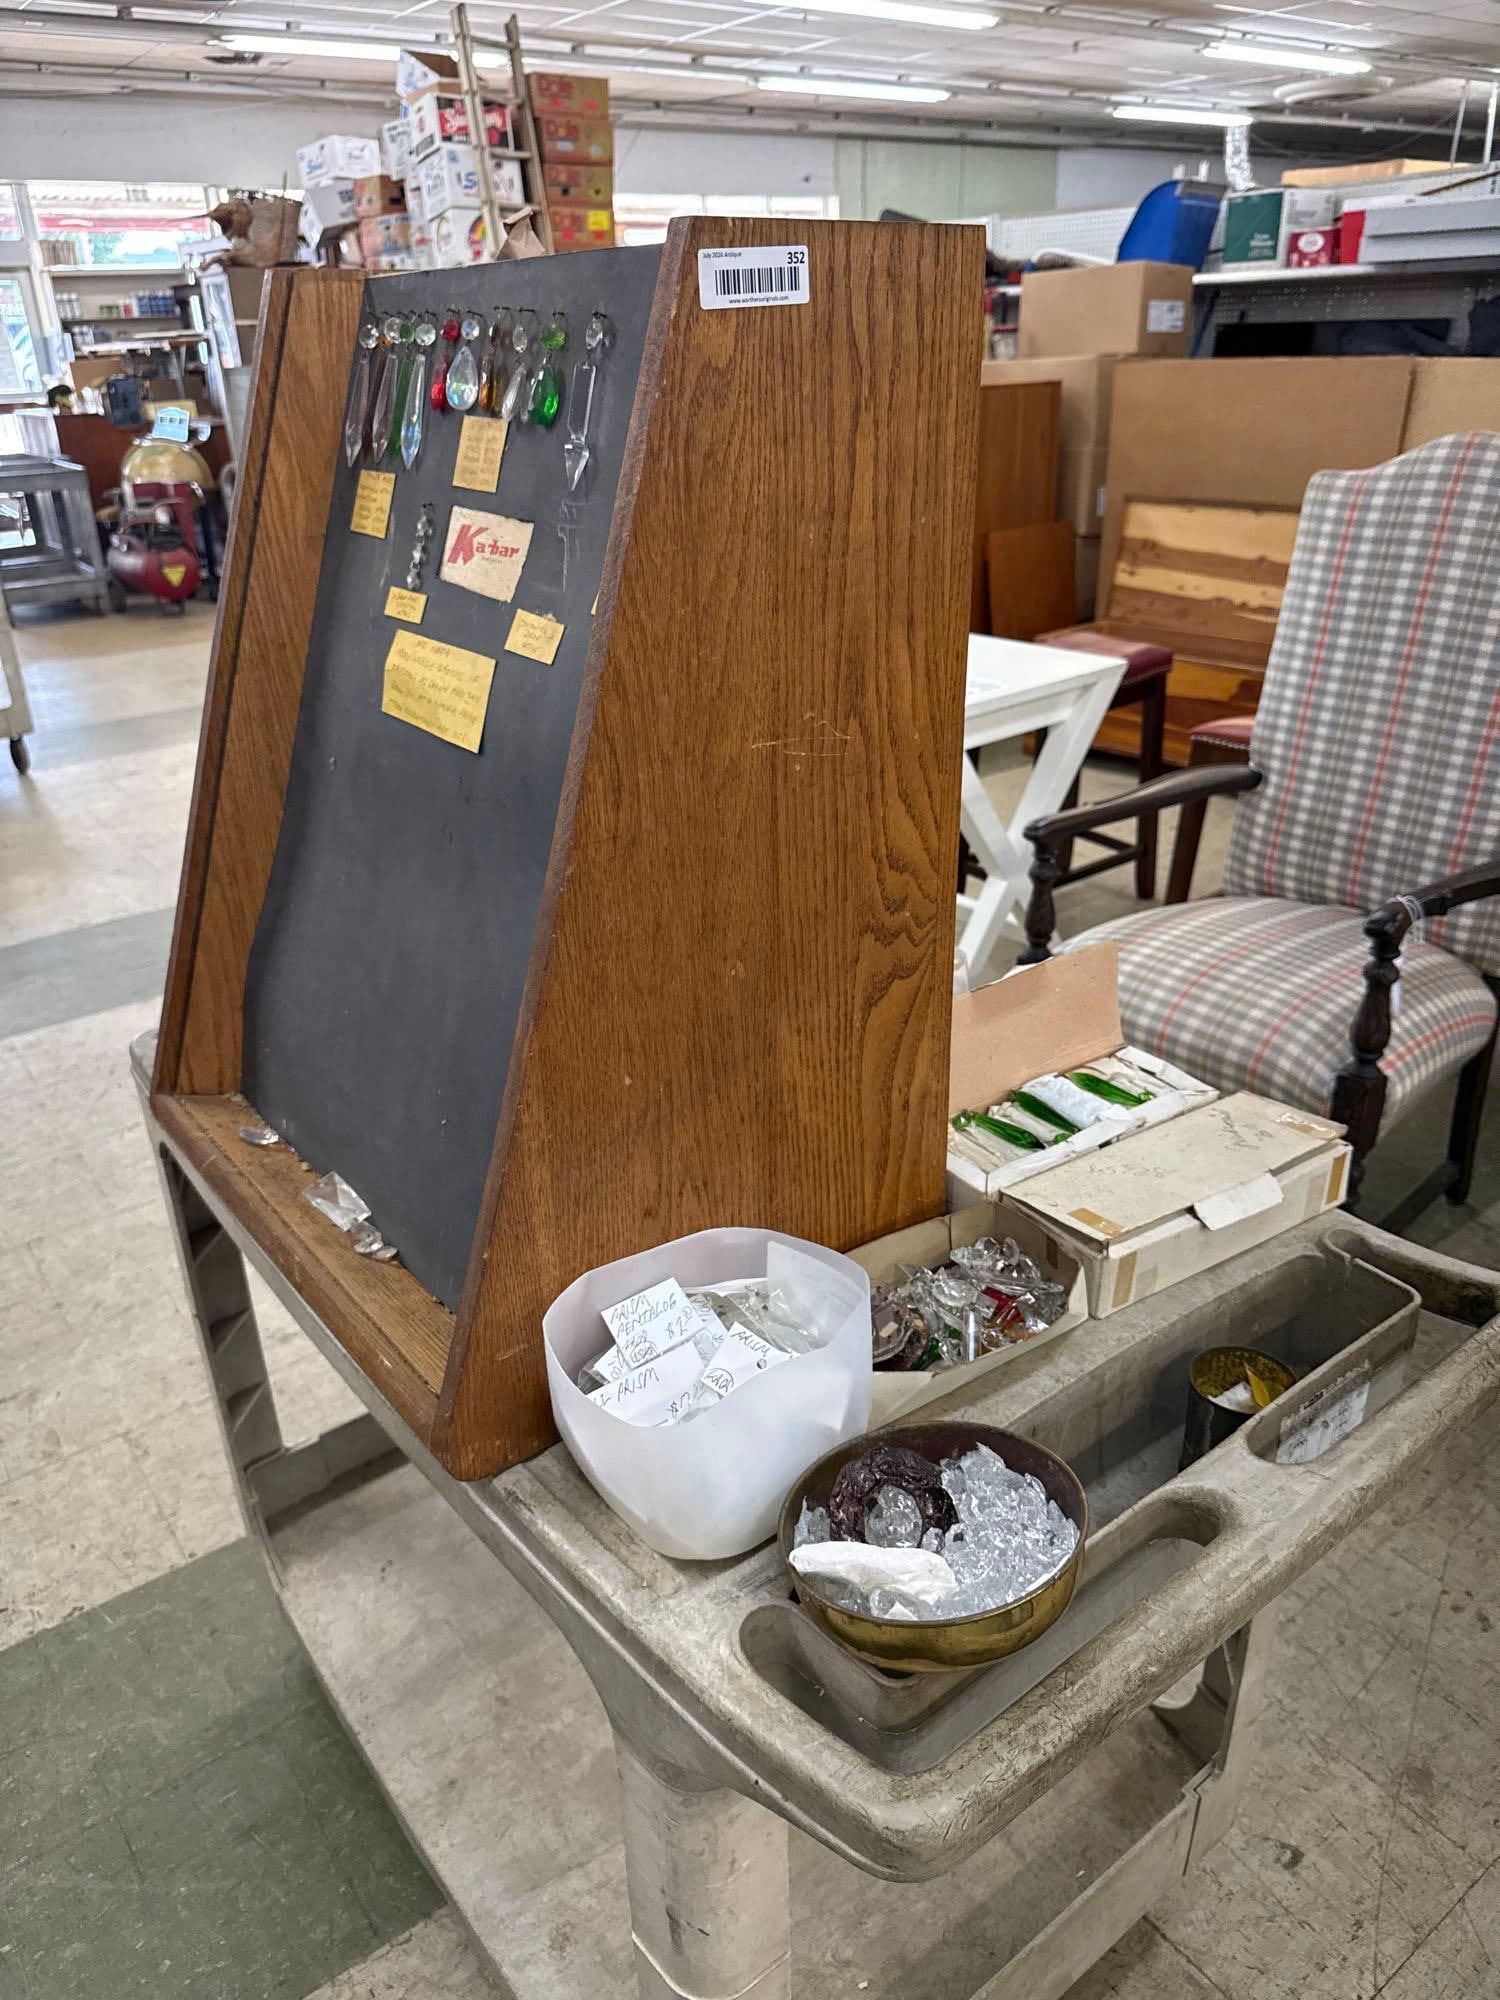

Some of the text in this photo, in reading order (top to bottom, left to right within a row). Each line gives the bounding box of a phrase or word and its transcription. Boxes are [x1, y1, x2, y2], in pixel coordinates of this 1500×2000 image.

[787, 251, 806, 264] 352
[610, 1294, 650, 1324] PRISM
[729, 1330, 771, 1358] PRISM
[617, 1367, 660, 1403] PRISM
